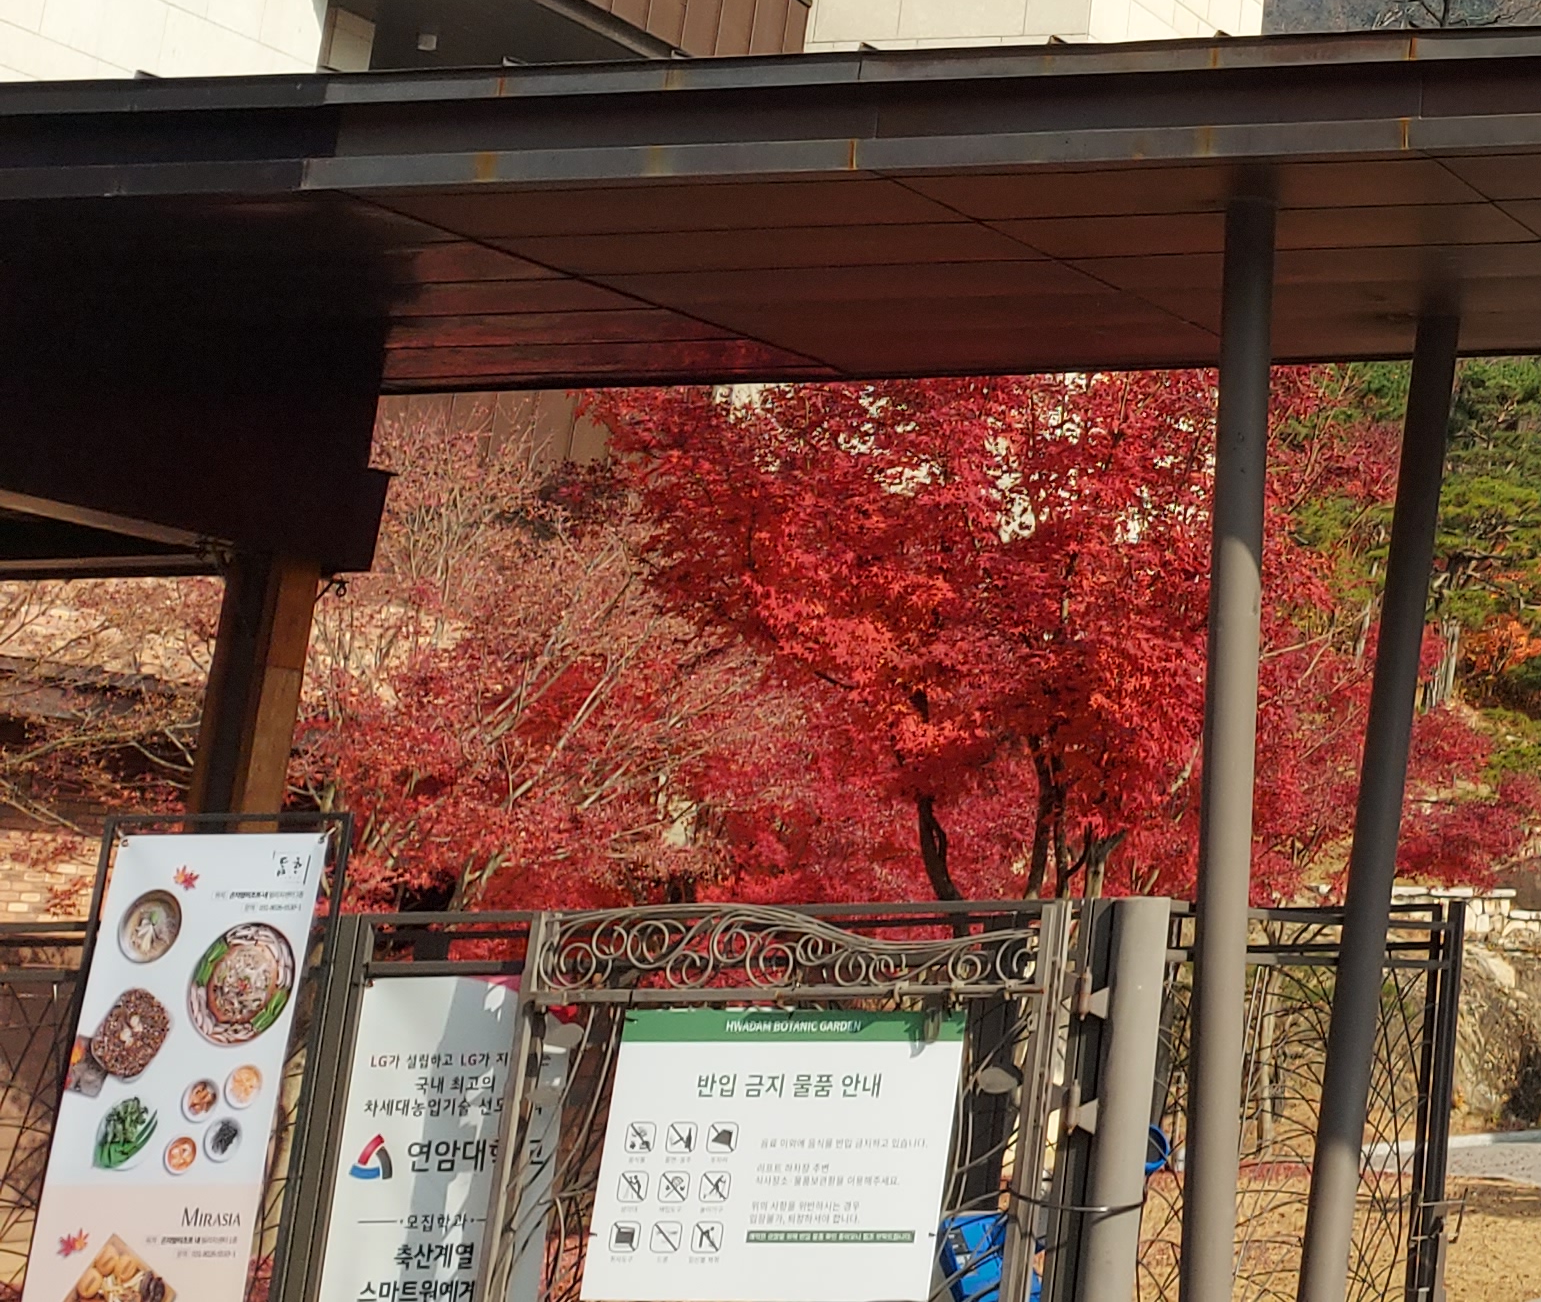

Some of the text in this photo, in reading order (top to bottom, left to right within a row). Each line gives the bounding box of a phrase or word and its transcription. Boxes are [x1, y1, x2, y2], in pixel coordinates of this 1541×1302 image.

[726, 1020, 861, 1032] HWADAM BOTANIC GARDEN
[370, 1054, 400, 1069] LG가
[407, 1053, 453, 1069] 설립하고
[461, 1052, 490, 1067] LG가
[415, 1075, 496, 1095] 국내 최고의
[697, 1073, 882, 1098] 반입 금지 물품 안내
[404, 1210, 467, 1235] 모집학과
[394, 1242, 475, 1271] 축산계열
